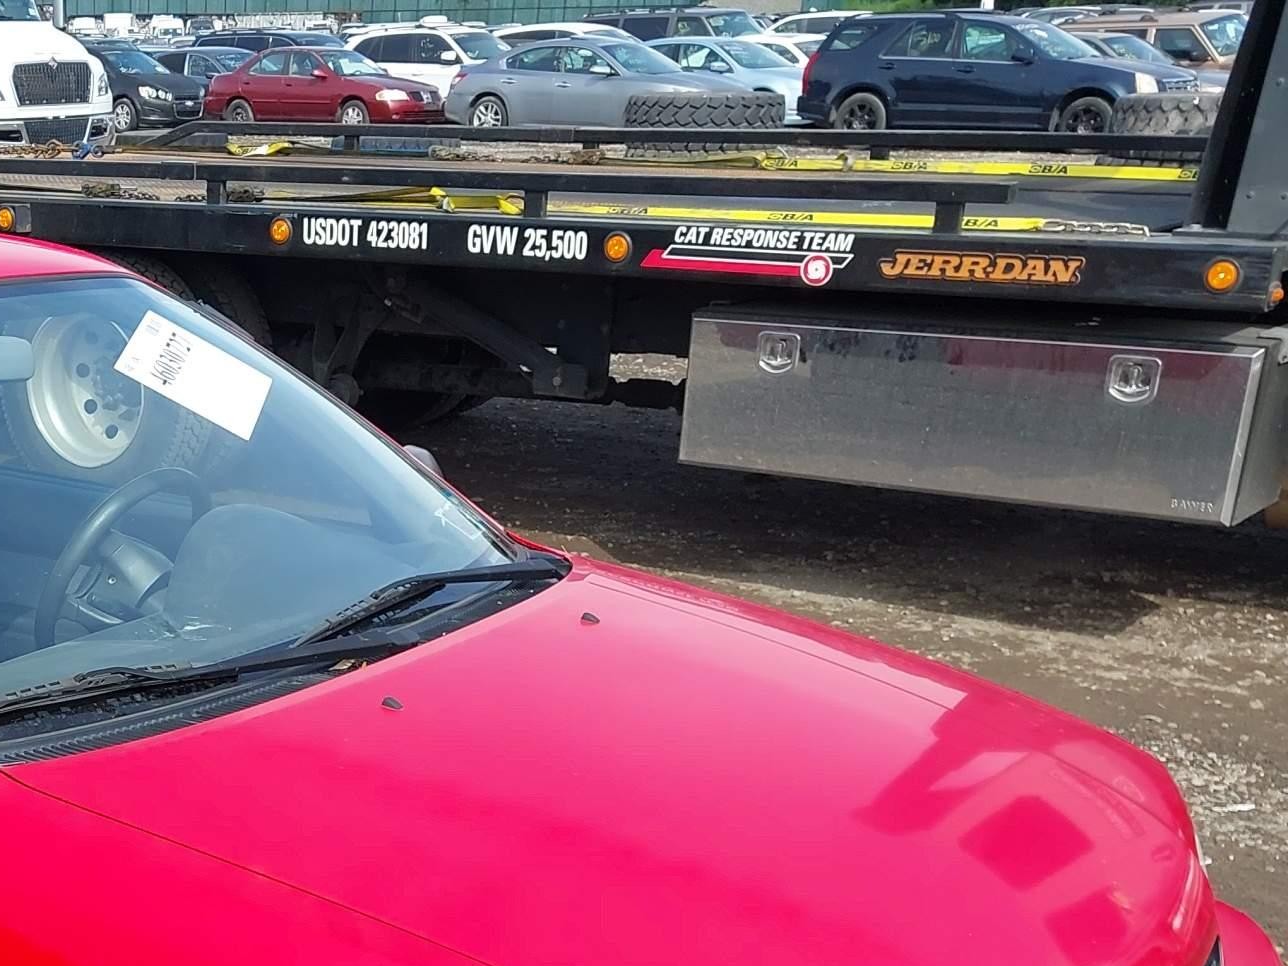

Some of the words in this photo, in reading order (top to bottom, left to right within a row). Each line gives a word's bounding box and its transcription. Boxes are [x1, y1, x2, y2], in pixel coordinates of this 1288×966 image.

[303, 217, 361, 247] USDOT
[366, 222, 428, 250] 423081
[467, 224, 518, 255] GVW
[522, 228, 588, 261] 25,500
[674, 225, 709, 245] CAT
[710, 227, 803, 250] RESPONSE
[803, 232, 855, 252] TEAM
